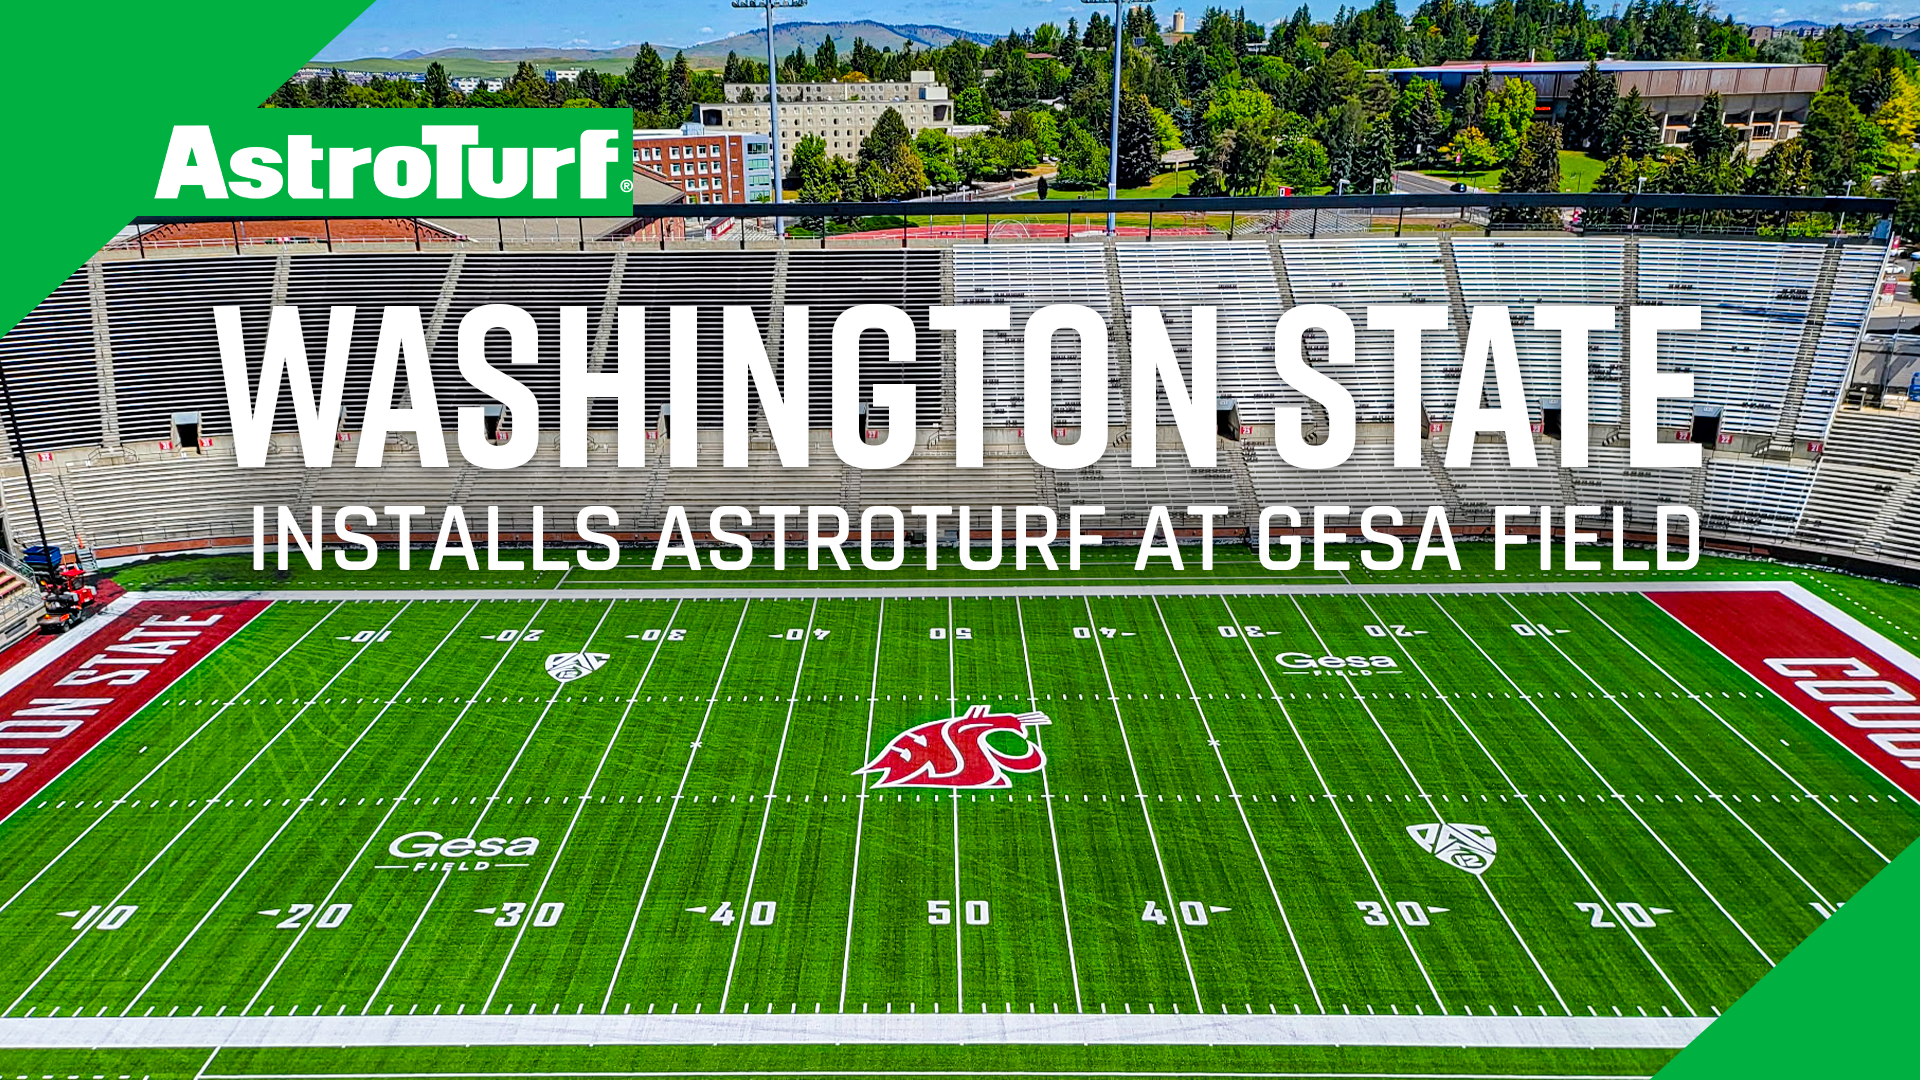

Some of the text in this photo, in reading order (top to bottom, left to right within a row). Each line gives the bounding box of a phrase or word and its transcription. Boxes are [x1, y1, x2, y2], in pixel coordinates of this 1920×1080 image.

[929, 628, 972, 640] 50
[53, 614, 224, 687] STATE
[1275, 652, 1398, 668] Gesa
[388, 831, 540, 858] Gesa
[413, 862, 490, 872] FIELD
[72, 905, 138, 930] 10
[276, 904, 352, 928] 20
[494, 902, 564, 927] 30
[709, 901, 776, 926] 40
[928, 901, 990, 925] 50
[1142, 901, 1208, 926] 40
[1354, 901, 1430, 926] 30
[1575, 902, 1656, 928] 20
